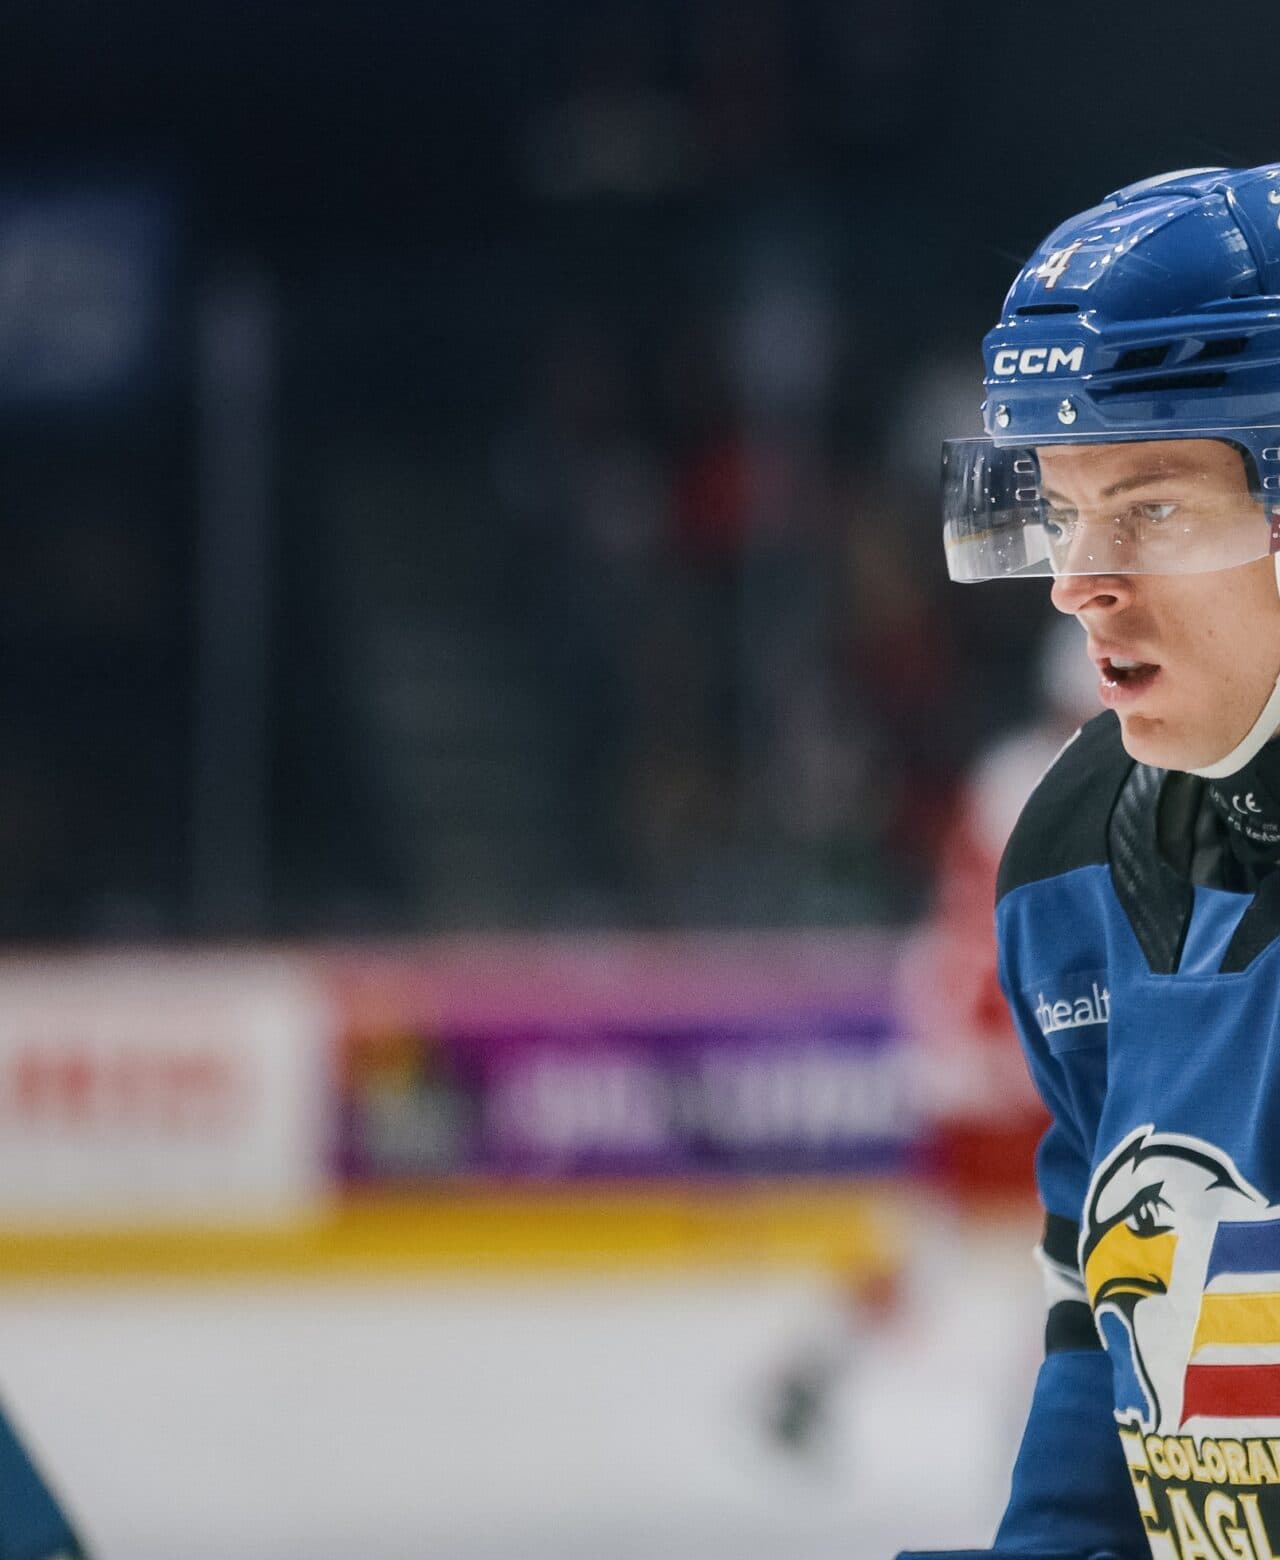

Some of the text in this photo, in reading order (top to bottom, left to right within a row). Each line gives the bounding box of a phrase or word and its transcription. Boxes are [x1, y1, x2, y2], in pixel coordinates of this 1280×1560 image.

[1036, 242, 1084, 289] 4
[993, 347, 1084, 376] CCM
[1232, 792, 1262, 815] CE
[1035, 982, 1110, 1035] healt
